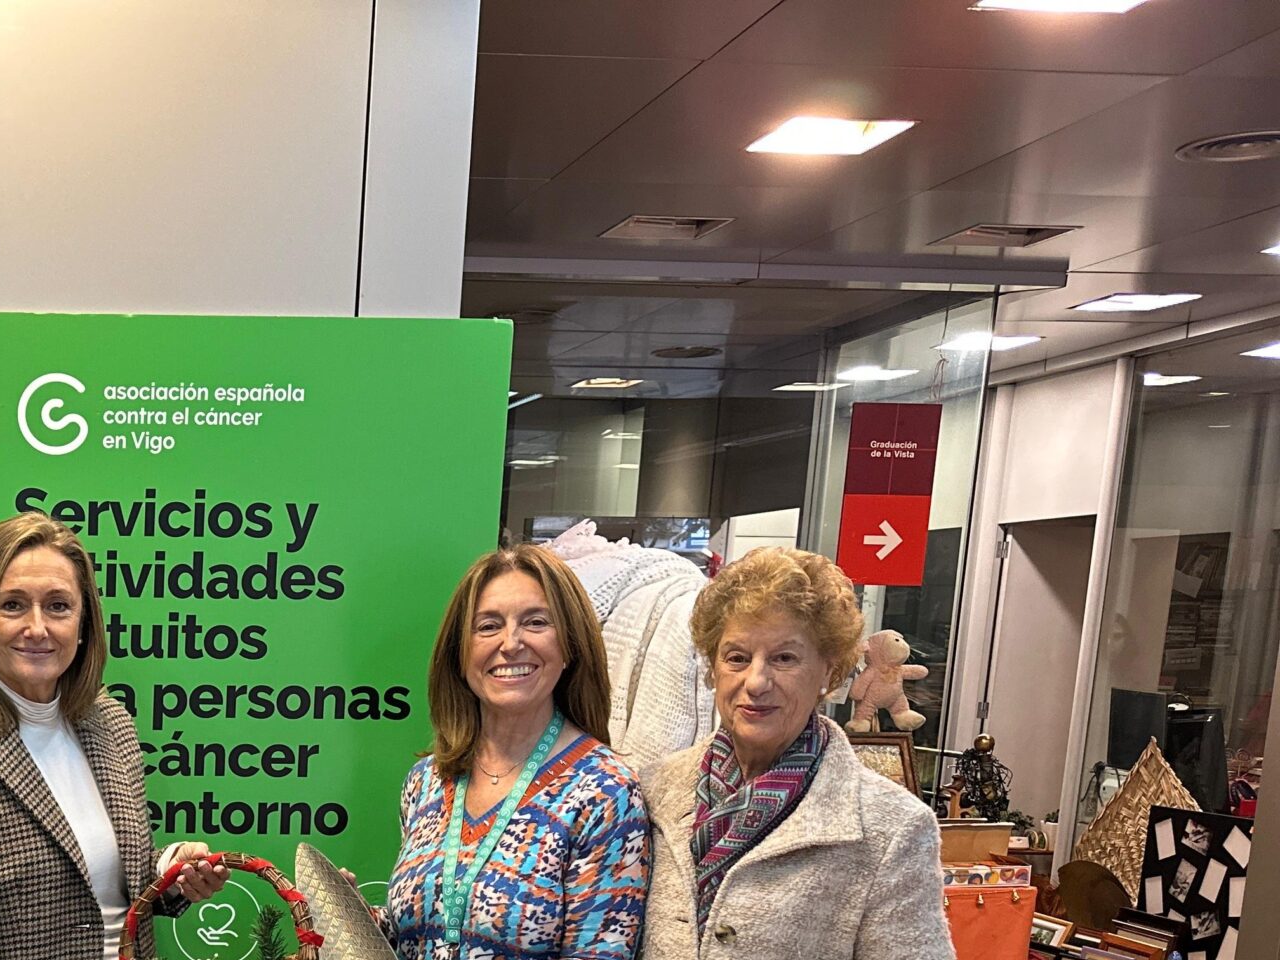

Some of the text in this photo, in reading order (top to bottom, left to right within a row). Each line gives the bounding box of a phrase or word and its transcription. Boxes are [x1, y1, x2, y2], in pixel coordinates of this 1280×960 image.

[103, 382, 305, 407] asociación española
[103, 406, 263, 427] contra el cáncer
[102, 431, 176, 454] en Vigo
[870, 440, 918, 450] Graduación
[870, 450, 915, 459] de la Vista
[15, 487, 319, 553] Servicios y
[153, 681, 411, 731] personas
[140, 730, 320, 778] cáncer
[146, 791, 349, 837] entorno
